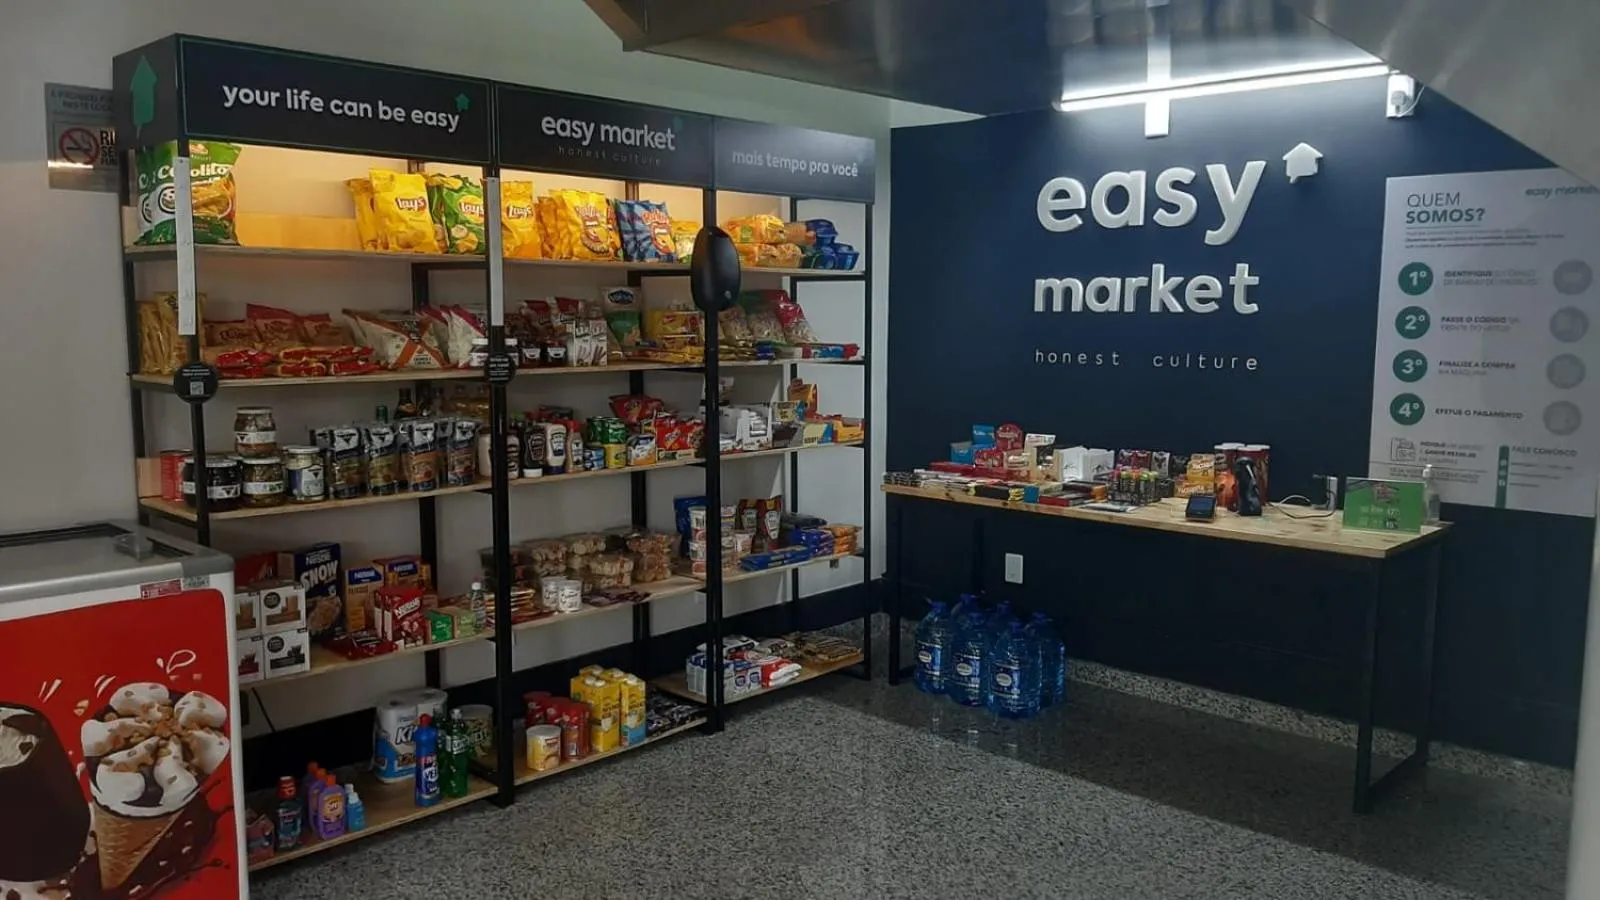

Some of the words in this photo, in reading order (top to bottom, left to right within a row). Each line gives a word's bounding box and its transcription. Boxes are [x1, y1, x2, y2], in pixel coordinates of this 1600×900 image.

[222, 85, 280, 107] your
[286, 88, 324, 112] life
[330, 98, 372, 118] can
[378, 100, 405, 122] be
[410, 109, 460, 132] easy
[541, 115, 595, 146] easy
[600, 124, 676, 151] market
[558, 146, 606, 160] honest
[612, 153, 661, 167] culture
[732, 149, 763, 167] mais
[766, 153, 807, 173] tempo
[809, 160, 829, 176] pra
[832, 162, 858, 177] você
[1037, 160, 1267, 245] easy
[1407, 192, 1461, 208] QUEM
[1406, 208, 1485, 224] SOMOS?
[1034, 263, 1260, 315] market
[1035, 349, 1120, 366] honest
[1153, 354, 1258, 370] culture
[301, 560, 338, 592] SNOW
